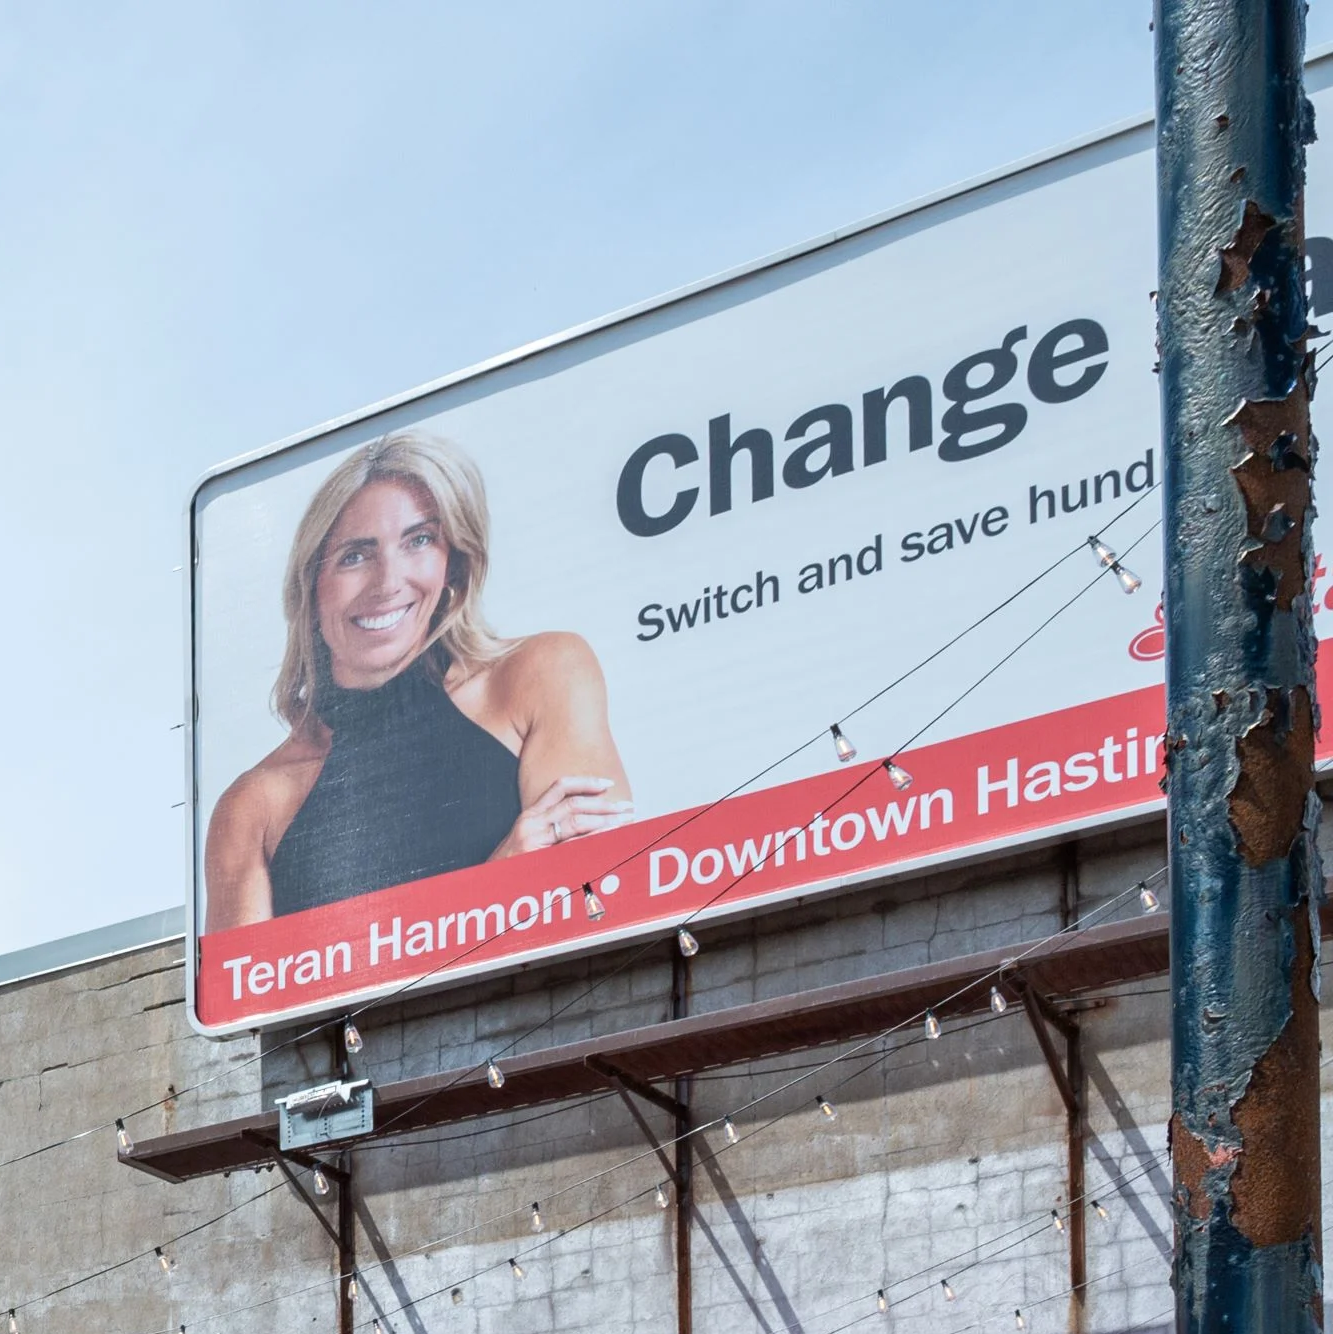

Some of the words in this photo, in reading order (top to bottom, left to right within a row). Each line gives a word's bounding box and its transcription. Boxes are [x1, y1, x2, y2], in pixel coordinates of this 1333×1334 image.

[616, 318, 1109, 537] Change
[636, 571, 779, 641] Switch
[797, 534, 883, 594] and
[900, 505, 1009, 562] save
[223, 941, 351, 1000] Teran
[369, 885, 571, 966] Harmon
[649, 788, 953, 897] Downtown
